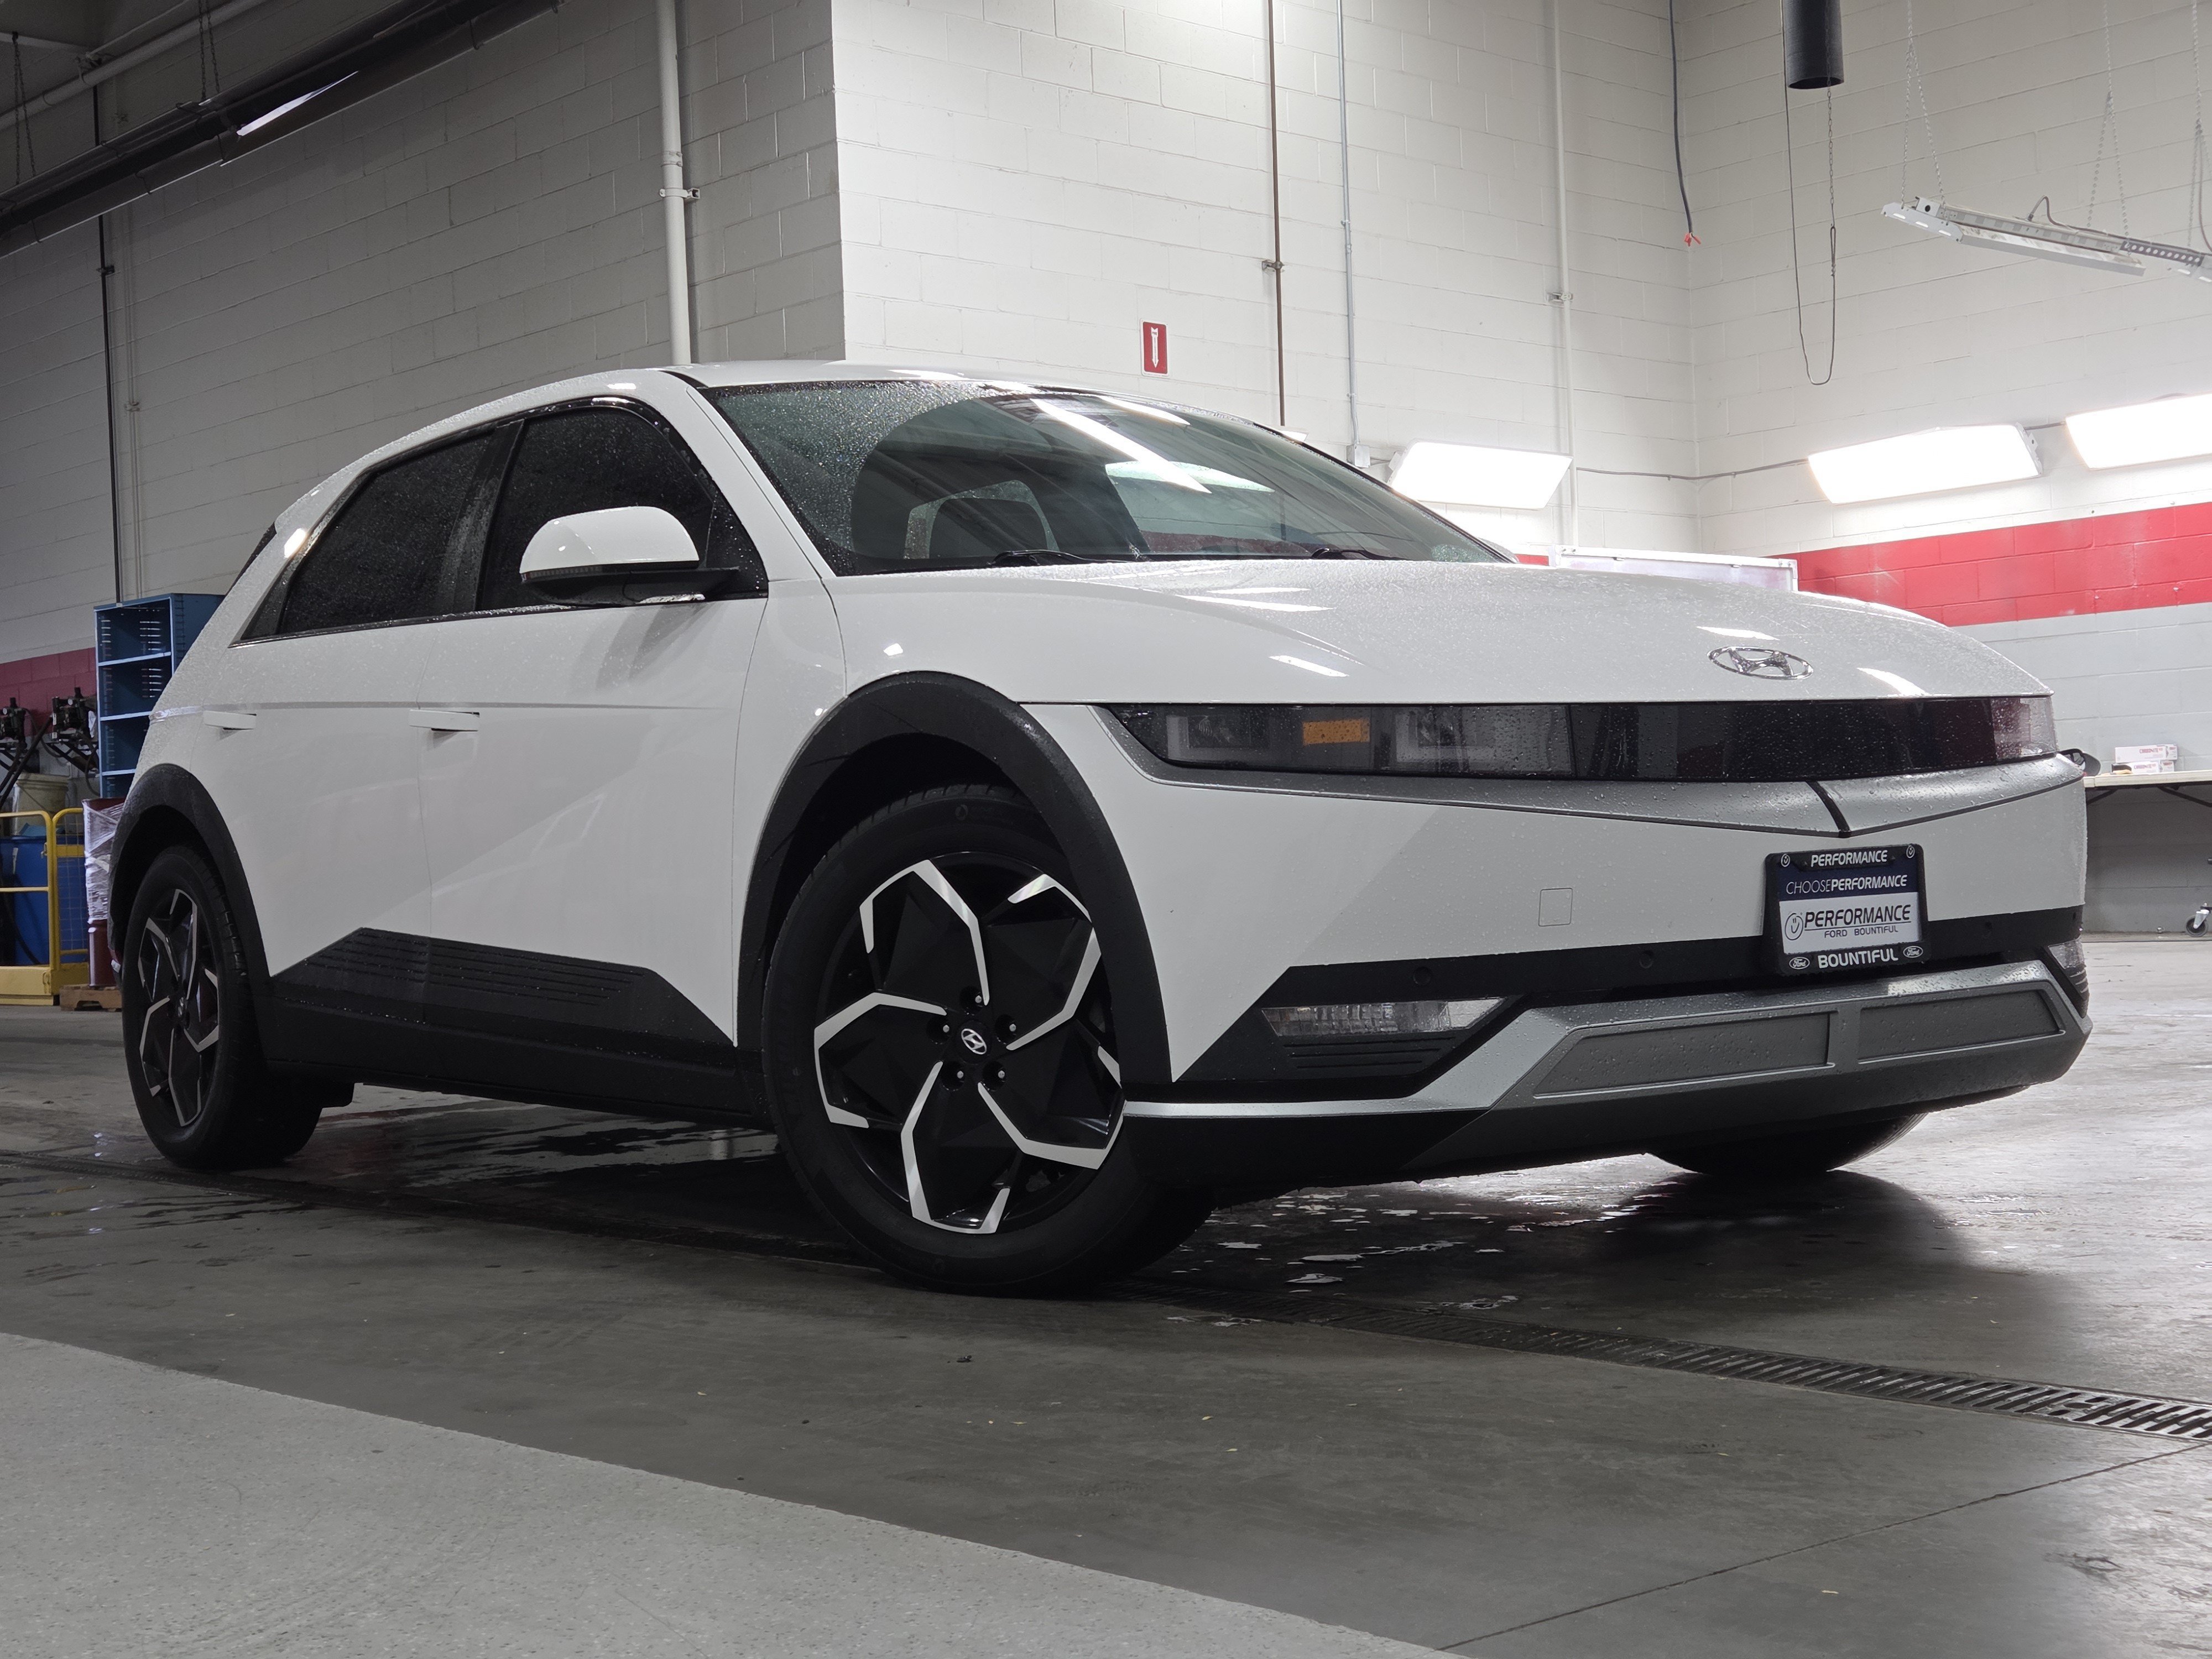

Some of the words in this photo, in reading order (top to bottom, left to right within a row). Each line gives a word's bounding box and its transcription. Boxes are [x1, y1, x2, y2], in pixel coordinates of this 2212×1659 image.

[1811, 850, 1887, 867] PERFORMANCE
[1786, 875, 1907, 894] CHOOSEPERFORMANCE
[1804, 905, 1911, 928] PERFORMANCE
[1825, 930, 1847, 938] FORD
[1854, 925, 1898, 936] BOUNTIFUL
[1818, 948, 1898, 968] BOUNTIFUL
